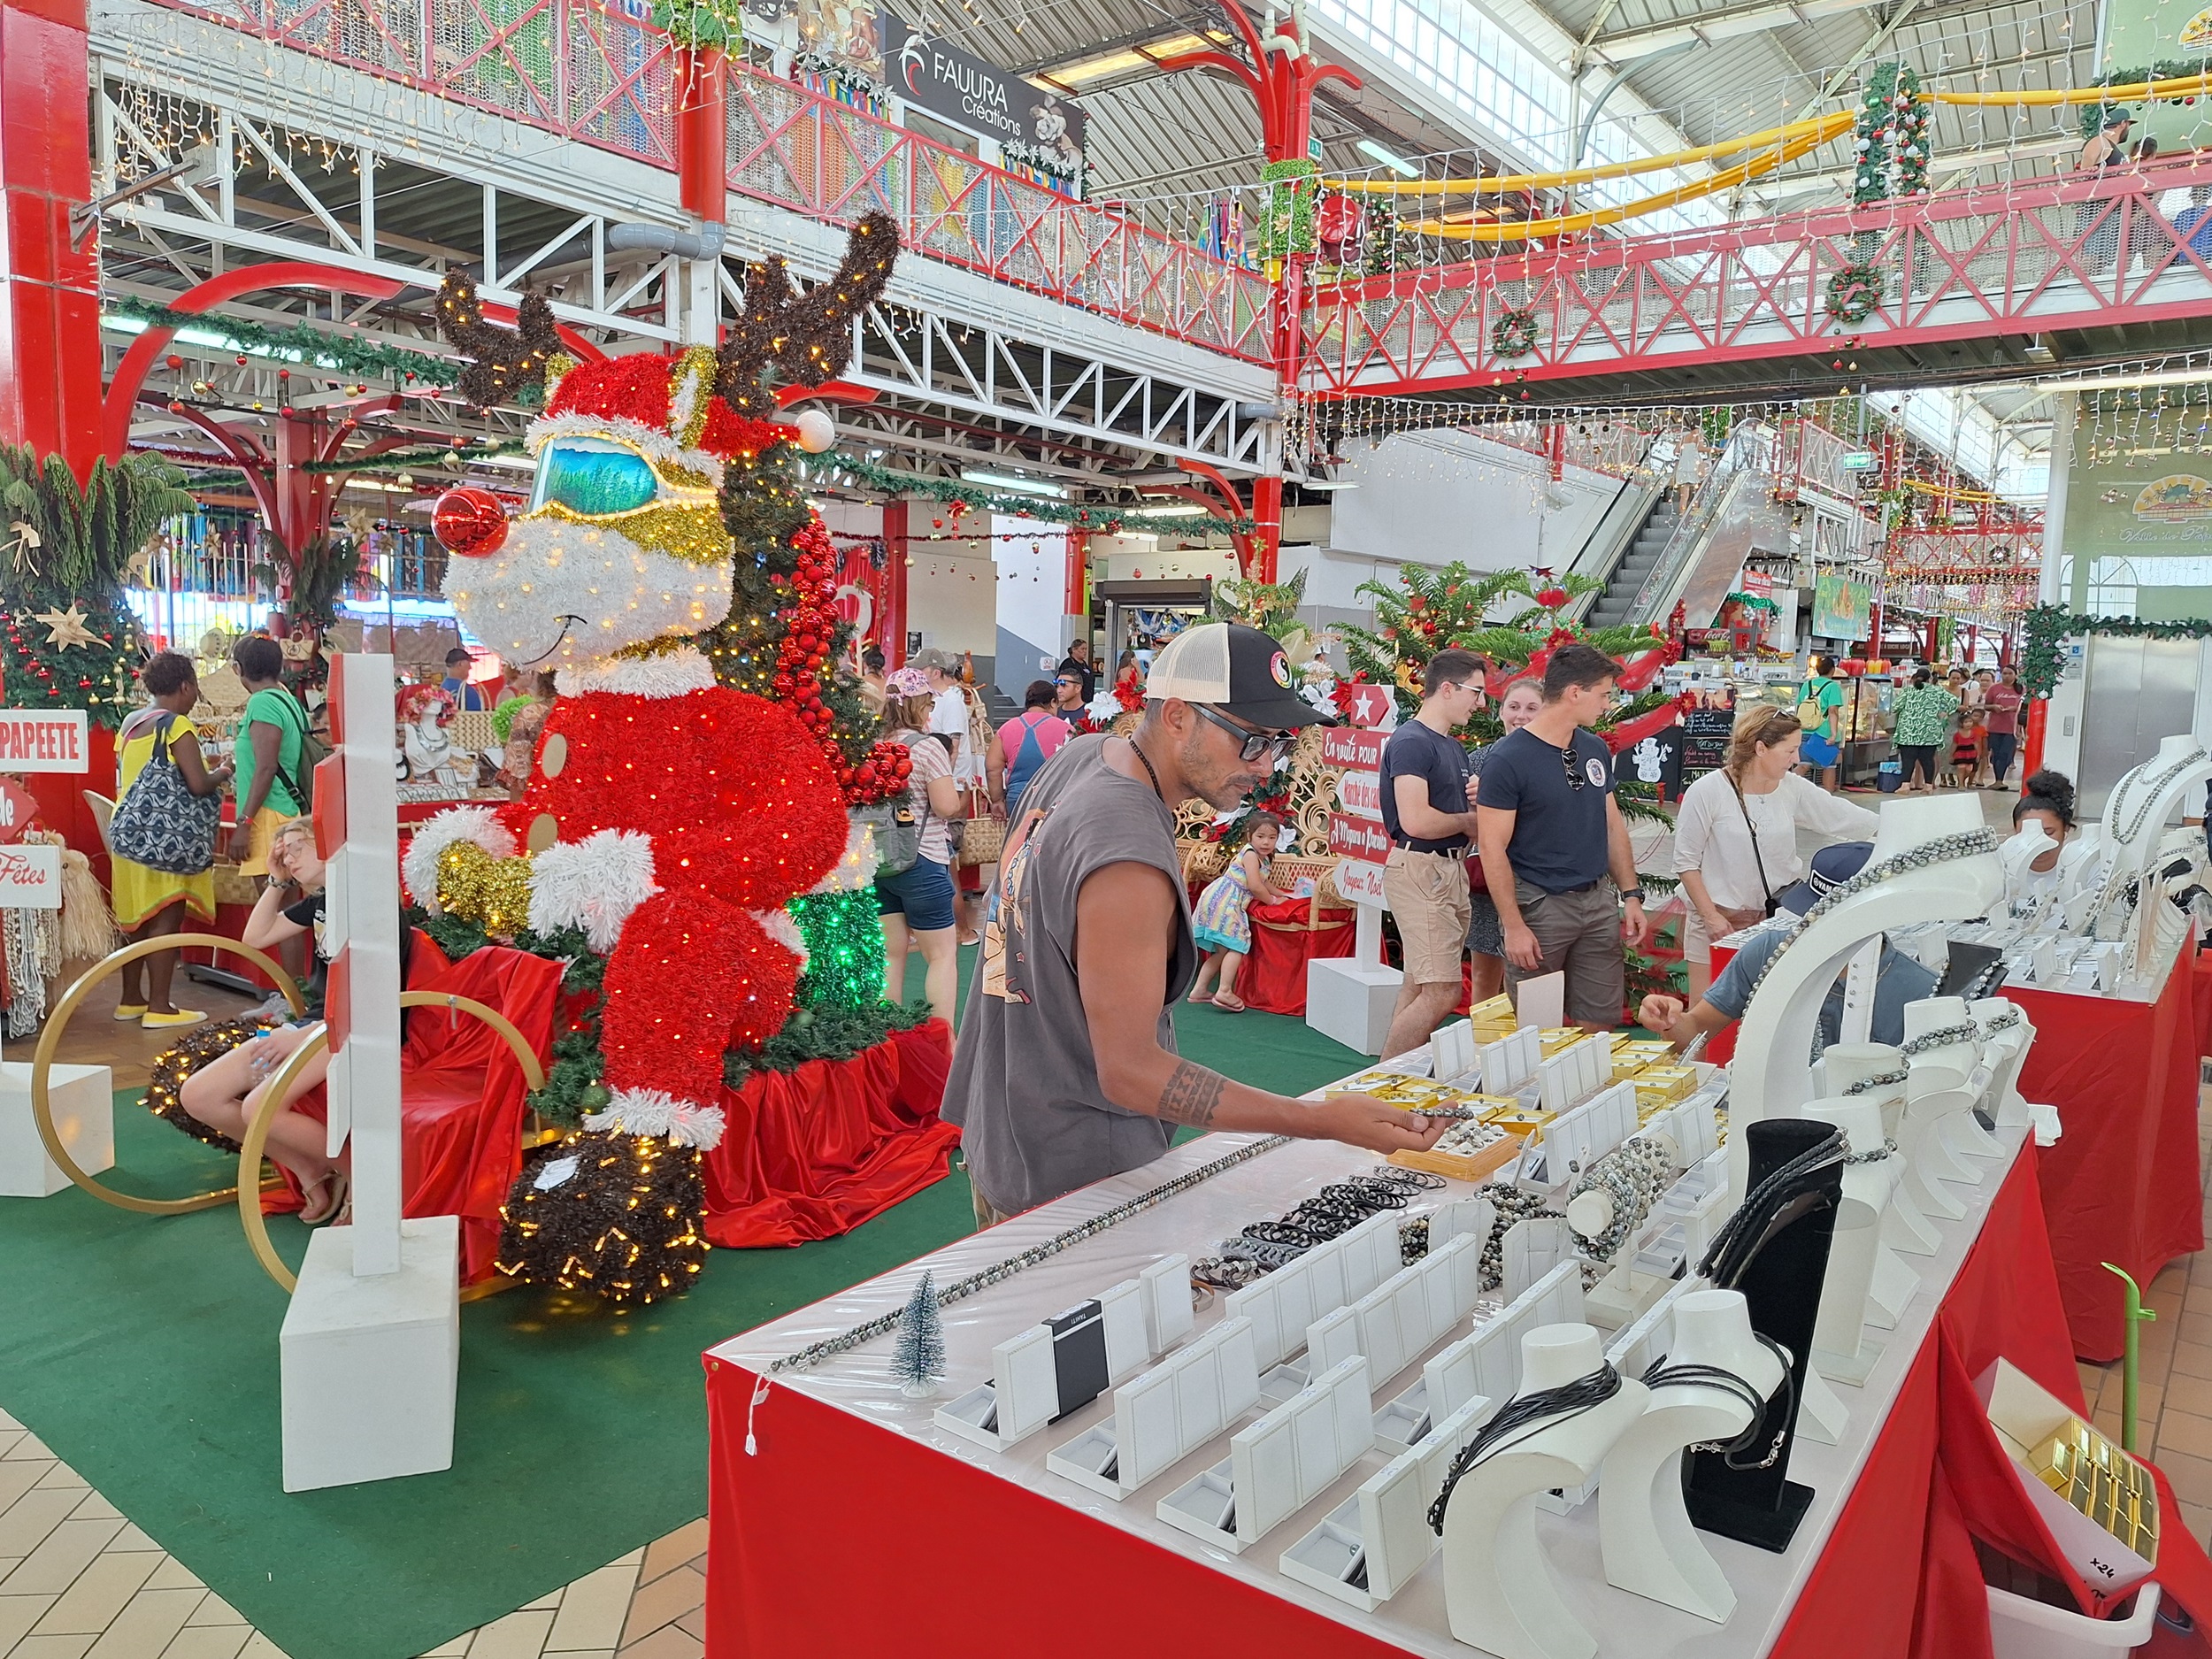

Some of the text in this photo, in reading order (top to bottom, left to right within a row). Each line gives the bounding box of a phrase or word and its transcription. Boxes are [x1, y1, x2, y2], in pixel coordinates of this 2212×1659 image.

[934, 52, 1009, 112] FAUURA
[962, 96, 1021, 136] Créations
[2180, 526, 2212, 542] Pap
[0, 722, 80, 760] PAPEETE
[1325, 732, 1335, 757] En
[1358, 746, 1377, 765] POUR
[1344, 779, 1361, 807] Marché
[0, 852, 47, 885] Fêtes
